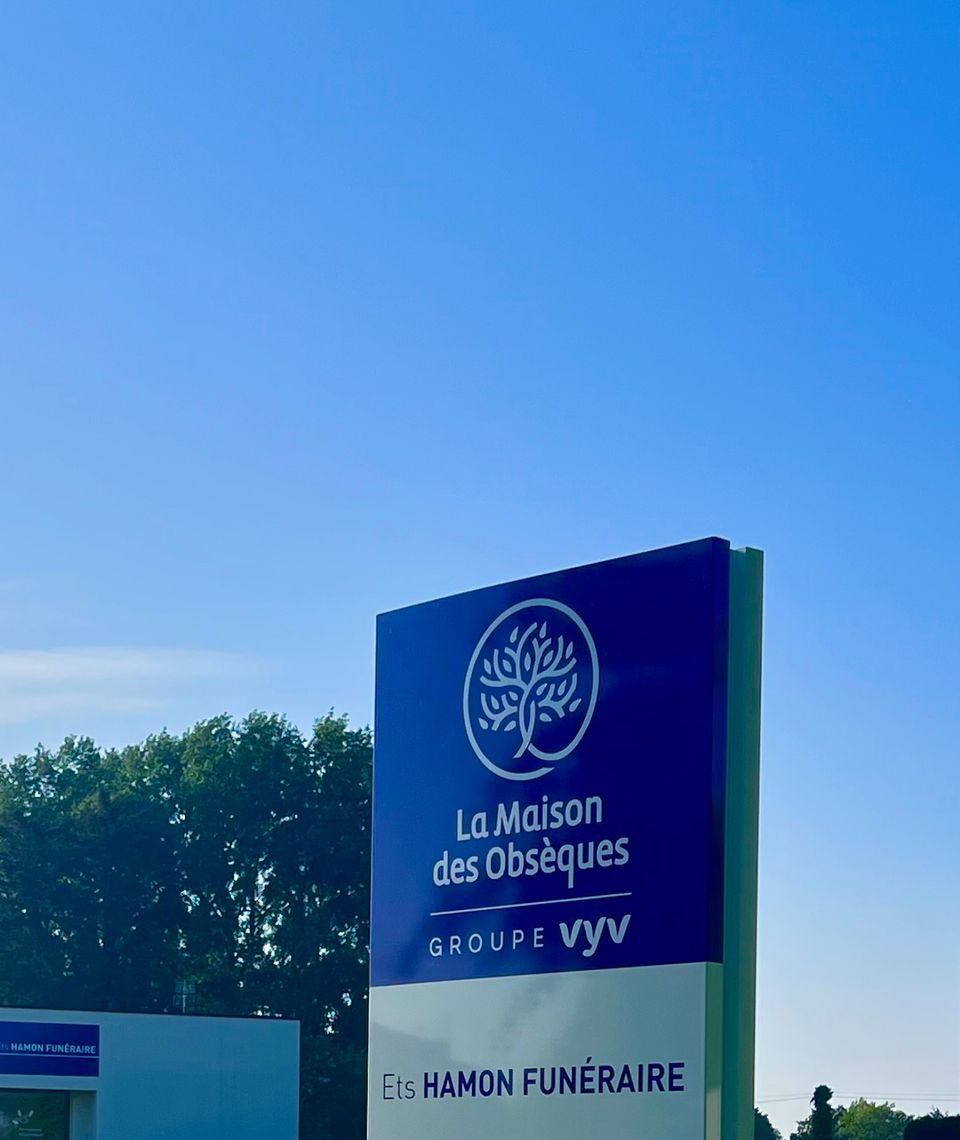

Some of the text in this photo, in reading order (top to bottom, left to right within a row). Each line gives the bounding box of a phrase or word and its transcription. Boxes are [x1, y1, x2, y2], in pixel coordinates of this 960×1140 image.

[457, 795, 602, 841] La Maison
[433, 837, 629, 888] des Obsèques
[429, 914, 631, 957] GROUPE vyv
[11, 1043, 44, 1052] HAMON
[46, 1043, 96, 1054] FUNÉRAIRE
[383, 1057, 685, 1100] Ets HAMON FUNÉRAIRE
